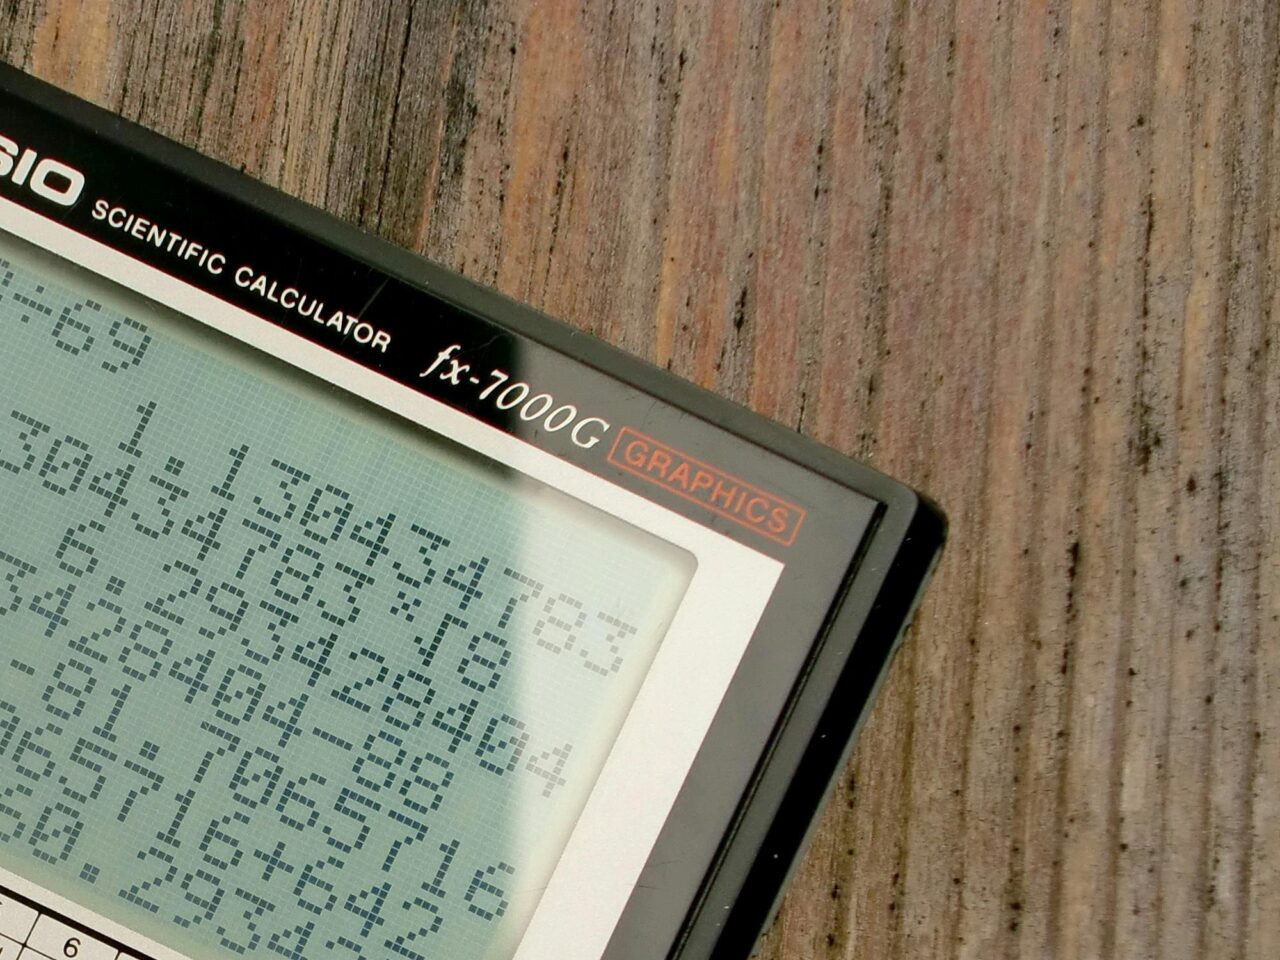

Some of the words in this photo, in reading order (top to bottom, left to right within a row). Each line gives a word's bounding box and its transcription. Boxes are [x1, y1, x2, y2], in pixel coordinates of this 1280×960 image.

[92, 200, 225, 274] SCIENTIFIC
[235, 266, 391, 352] CALCULATOR
[421, 345, 609, 448] fx-7000G
[117, 400, 637, 676] 1.130434783
[625, 440, 787, 532] GRAPHICS
[54, 519, 548, 797] 6.293428404
[62, 936, 81, 958] 6
